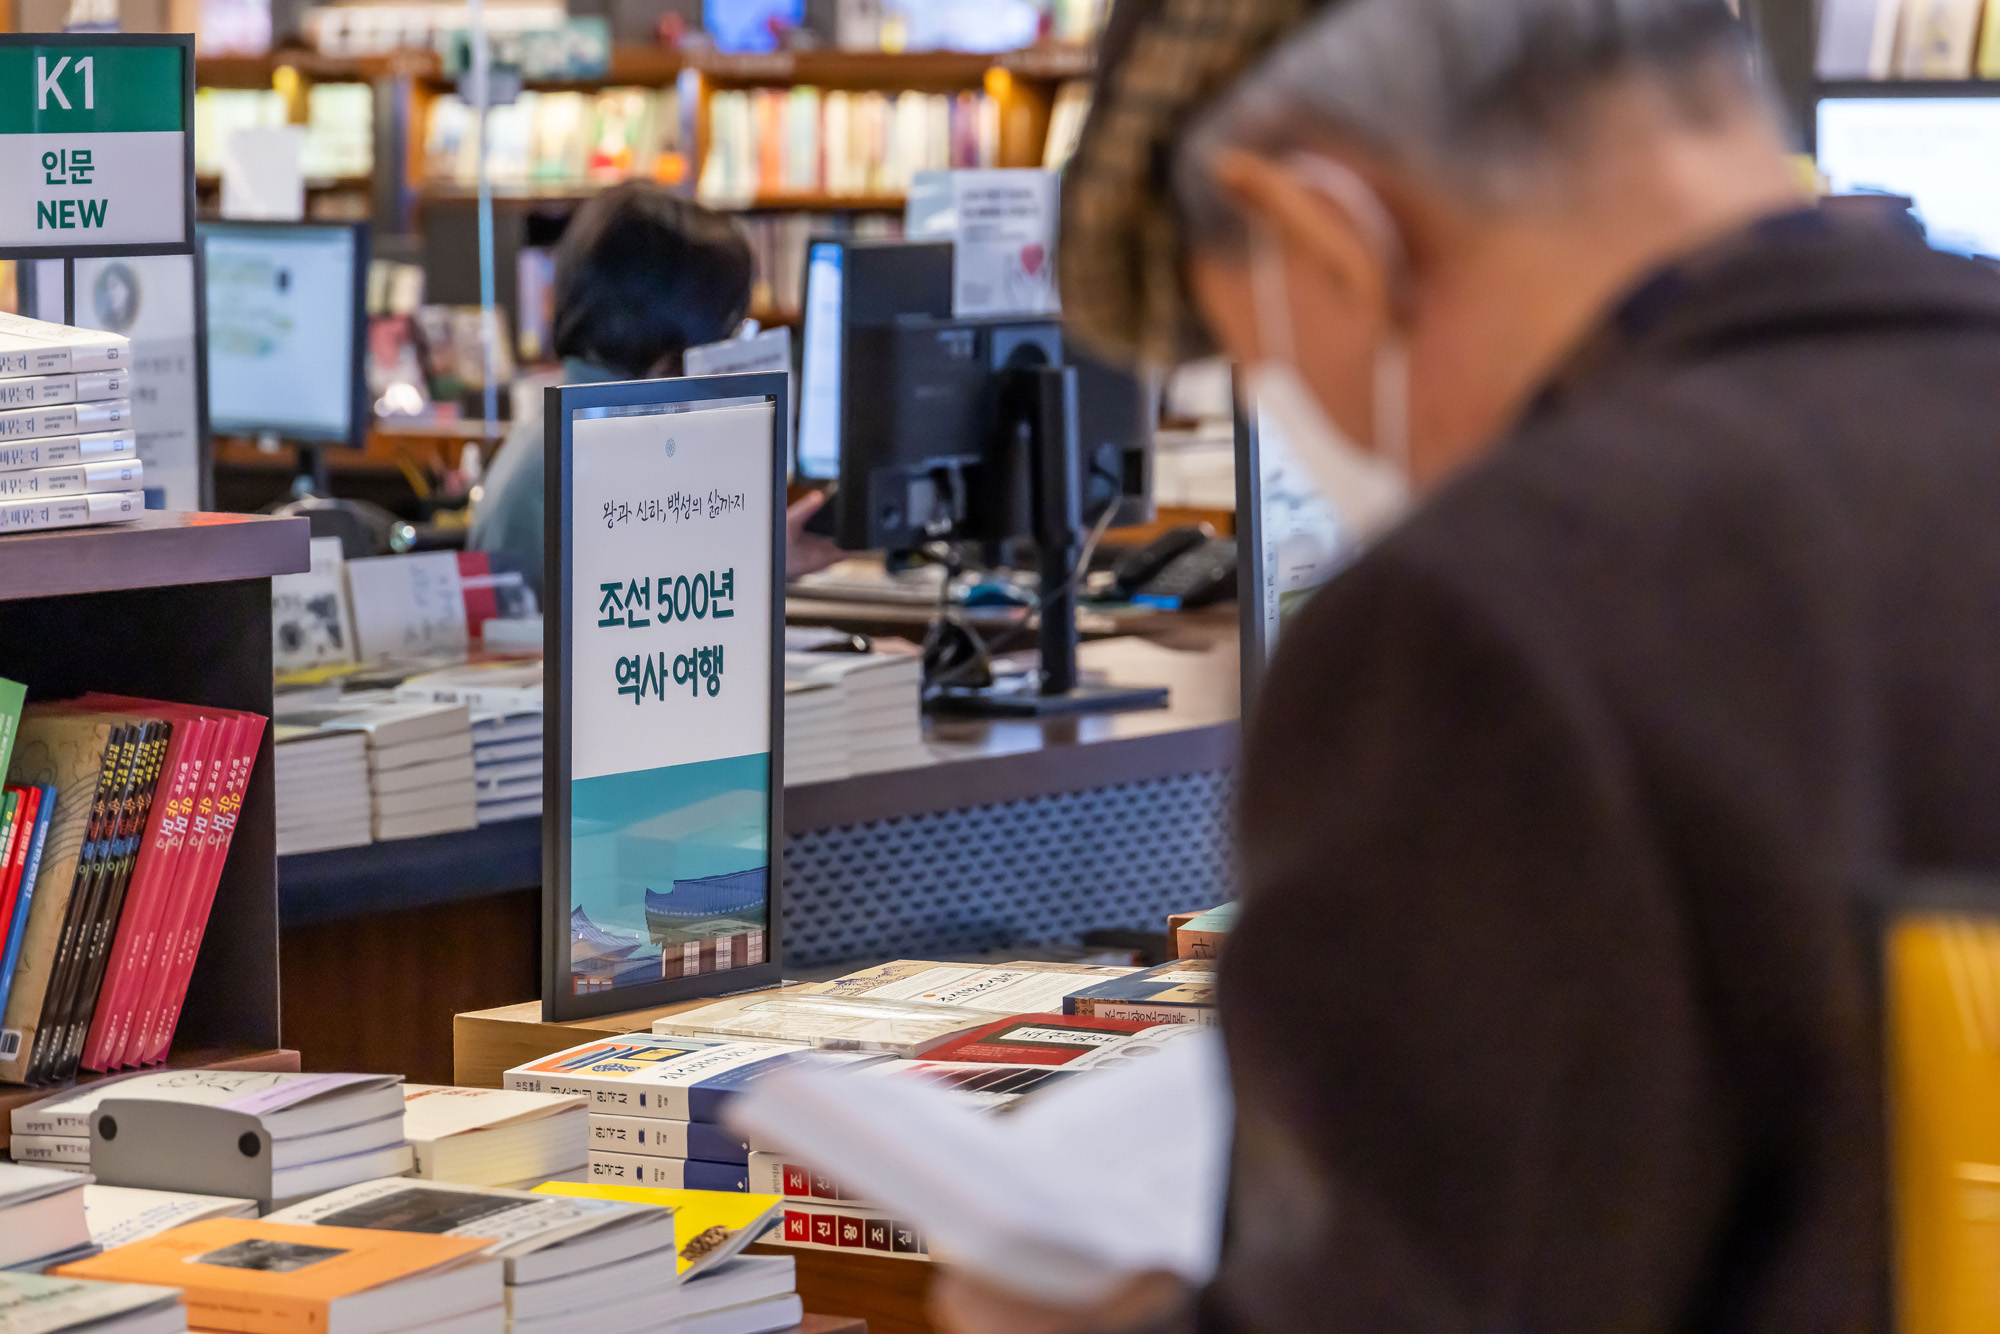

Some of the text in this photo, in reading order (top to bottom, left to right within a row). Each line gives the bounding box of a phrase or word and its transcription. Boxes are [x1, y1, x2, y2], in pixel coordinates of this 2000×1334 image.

[37, 56, 94, 110] K1
[42, 149, 95, 185] 인문
[37, 199, 108, 229] NEW
[602, 500, 632, 529] 왕과
[708, 488, 745, 519] 삶까지
[598, 567, 734, 628] 조선 500년
[615, 644, 724, 705] 역사 여행
[596, 1090, 628, 1105] 한국사
[595, 1126, 627, 1142] 한국사
[593, 1162, 625, 1178] 한국사
[790, 1218, 912, 1247] 조선왕조실
